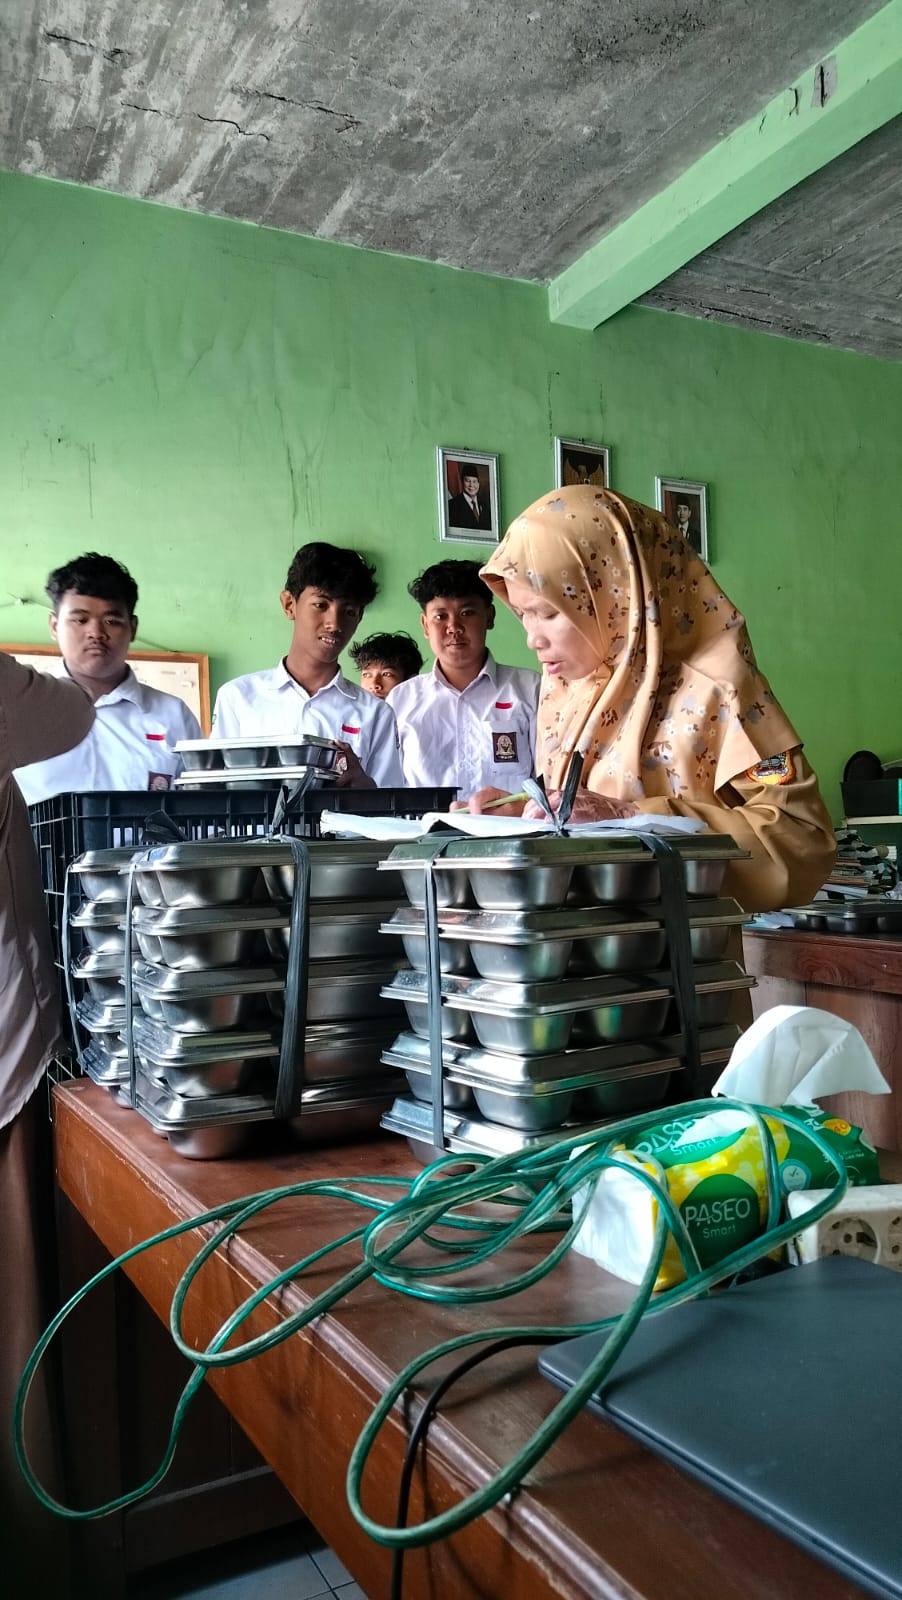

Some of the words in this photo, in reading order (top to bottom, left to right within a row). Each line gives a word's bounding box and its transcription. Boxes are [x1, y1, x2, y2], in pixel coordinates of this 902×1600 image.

[670, 1136, 717, 1156] Smart
[685, 1198, 750, 1228] PASEO
[703, 1224, 736, 1239] Smart
